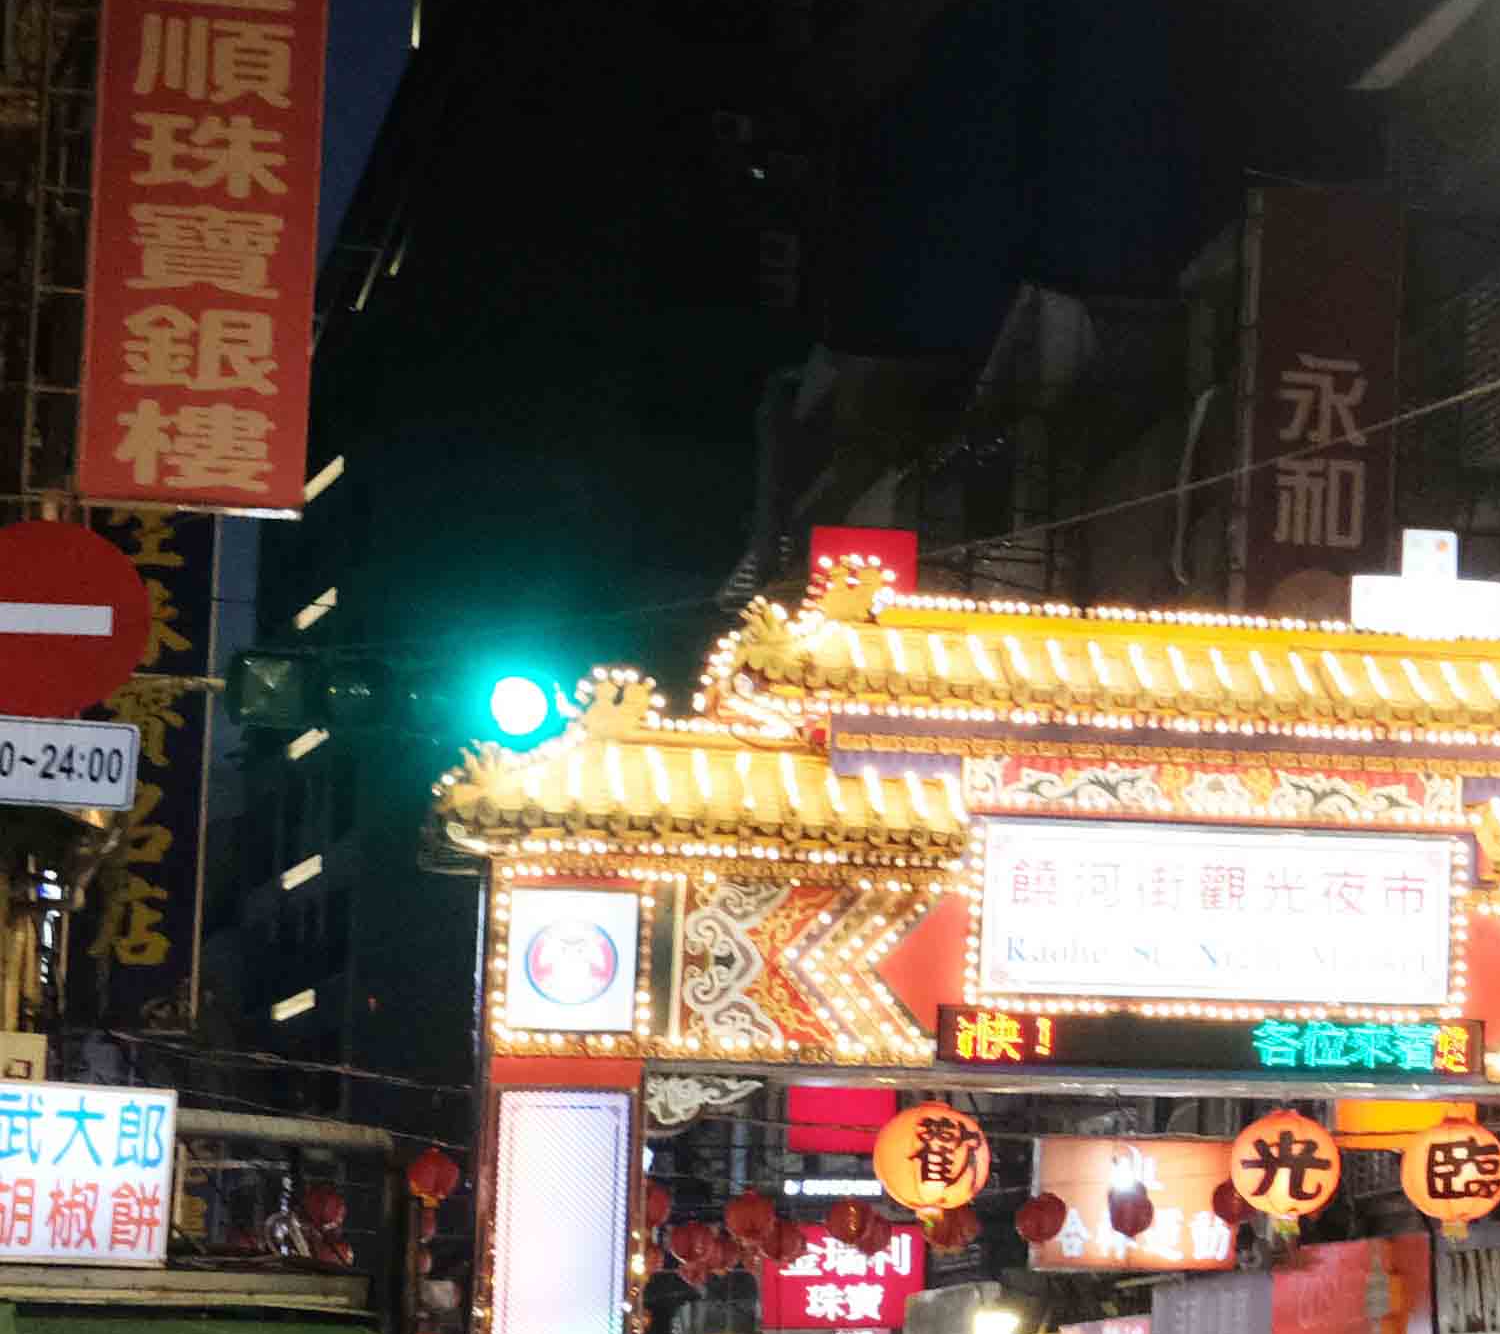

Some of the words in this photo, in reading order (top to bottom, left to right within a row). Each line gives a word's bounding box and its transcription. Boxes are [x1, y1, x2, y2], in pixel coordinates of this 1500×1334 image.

[1274, 352, 1367, 548] 永和
[1010, 858, 1429, 916] 饒河街觀光夜市
[1240, 1131, 1332, 1201] 光
